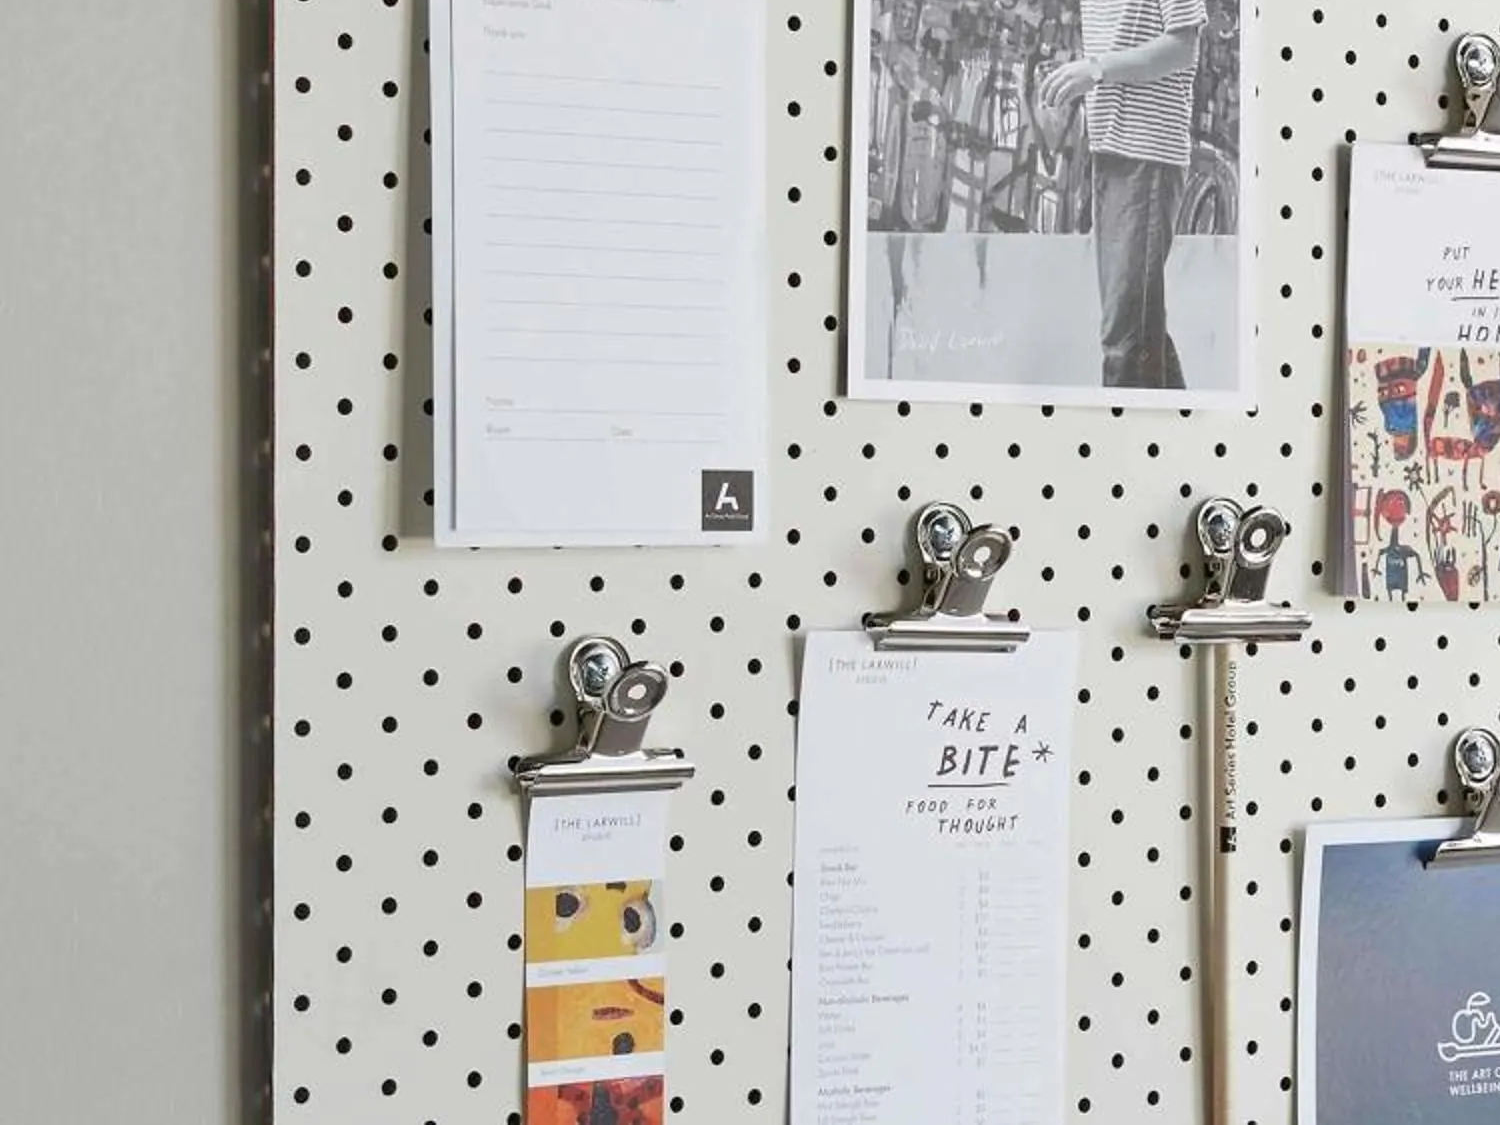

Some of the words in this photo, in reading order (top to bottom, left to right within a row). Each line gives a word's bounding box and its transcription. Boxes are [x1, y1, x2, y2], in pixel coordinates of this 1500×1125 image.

[1442, 246, 1470, 260] PUT
[1426, 276, 1464, 291] YOUR
[1471, 307, 1487, 317] IN
[1224, 661, 1237, 708] Group
[927, 699, 991, 733] TAKE
[1014, 714, 1028, 734] A
[1224, 710, 1237, 750] Hotel
[936, 745, 1020, 779] BITE
[1224, 753, 1237, 796] Series
[905, 800, 948, 814] FOOD
[966, 798, 997, 811] FOR
[1225, 799, 1237, 820] Art
[938, 815, 1019, 834] THOUGHT
[1448, 1070, 1469, 1082] THE
[1471, 1067, 1492, 1080] ART
